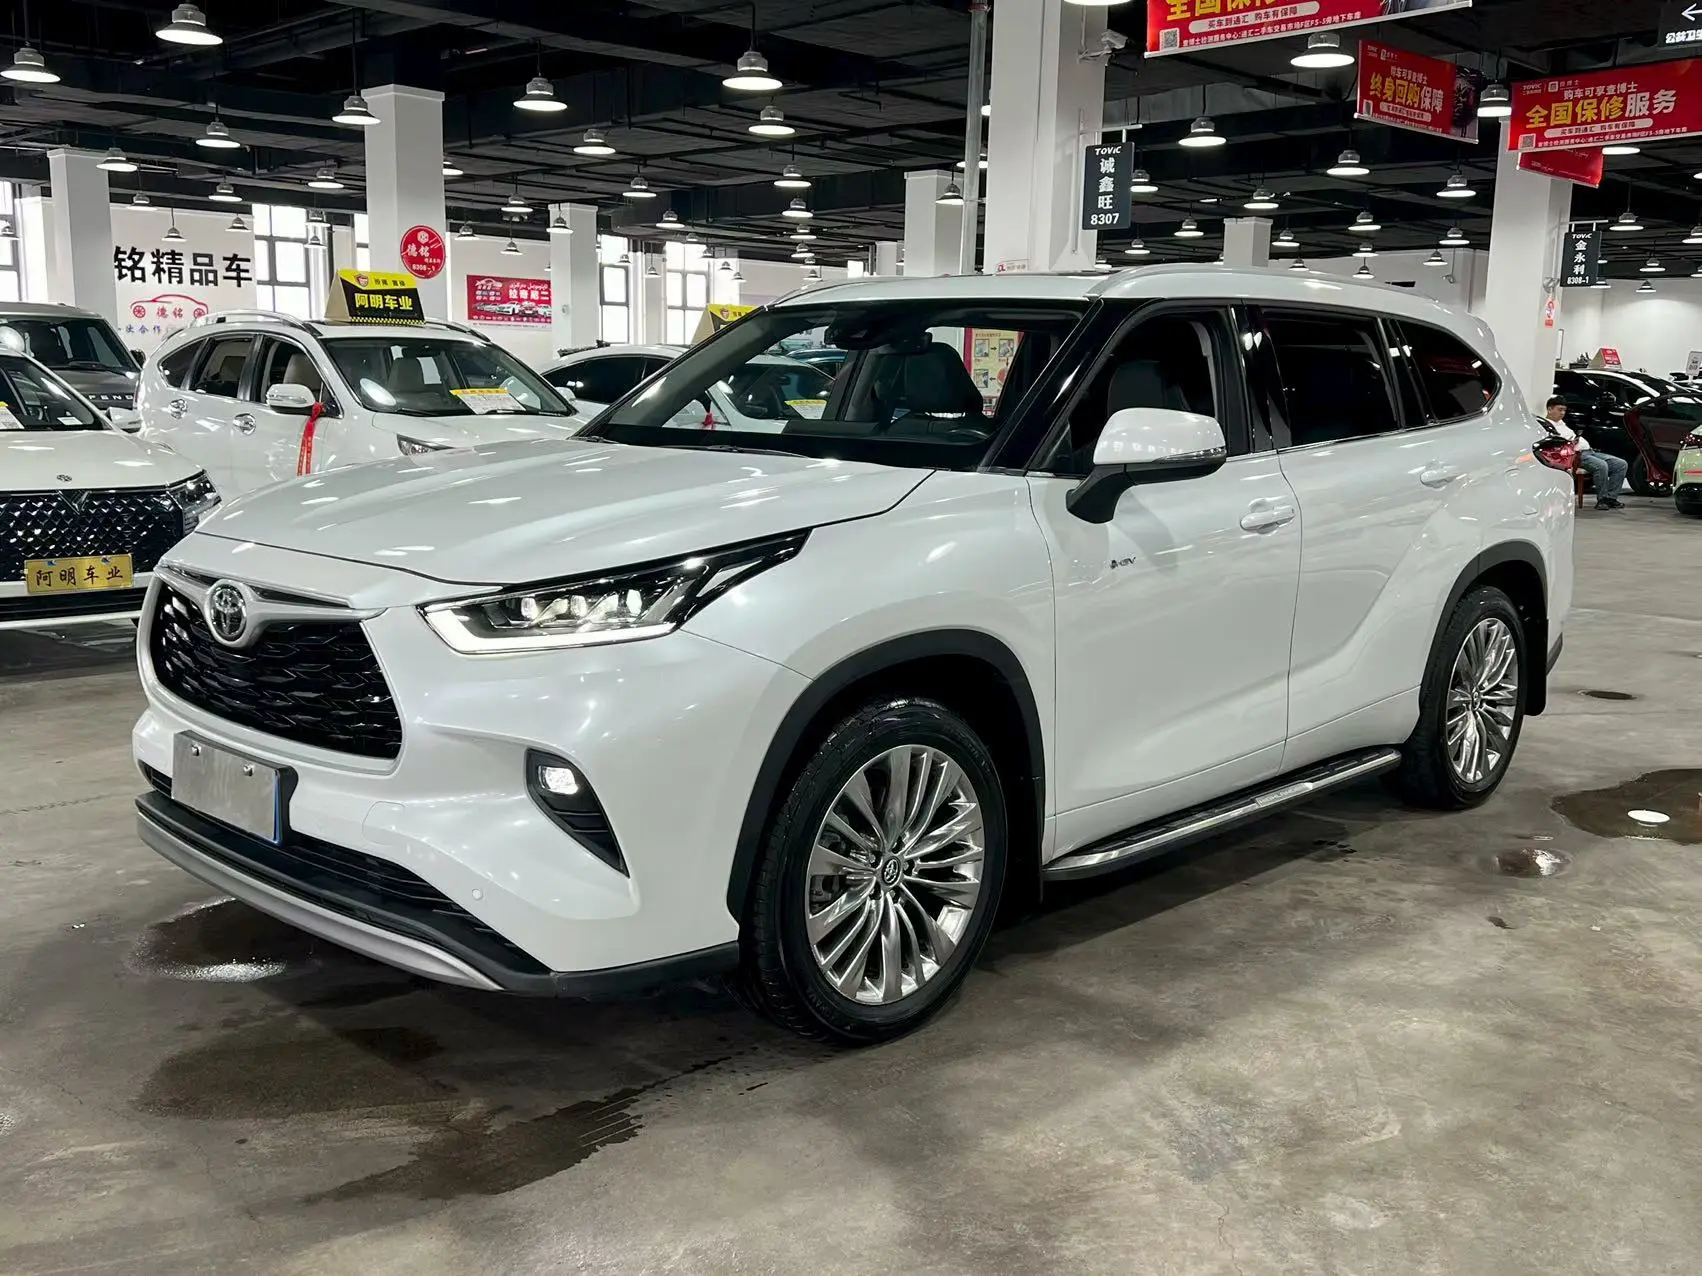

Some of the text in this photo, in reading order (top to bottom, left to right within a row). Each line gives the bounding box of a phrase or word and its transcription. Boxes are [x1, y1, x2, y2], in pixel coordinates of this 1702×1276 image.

[1167, 0, 1277, 20] 全国
[1207, 6, 1298, 29] 买车到通汇 购车有保障
[1369, 71, 1444, 114] 终身回购保障
[1563, 81, 1638, 100] 购车可享查博士
[1525, 89, 1677, 128] 全国保修服务
[1560, 121, 1636, 135] 买车到通汇 购车有保障
[1095, 146, 1122, 155] TOVIC
[1097, 157, 1115, 209] 诚鑫旺
[1090, 213, 1120, 225] 8307
[114, 245, 252, 288] 铭精品车
[1573, 240, 1588, 275] 金永利
[354, 293, 414, 311] 阿明车业
[36, 565, 124, 587] 阿明车业
